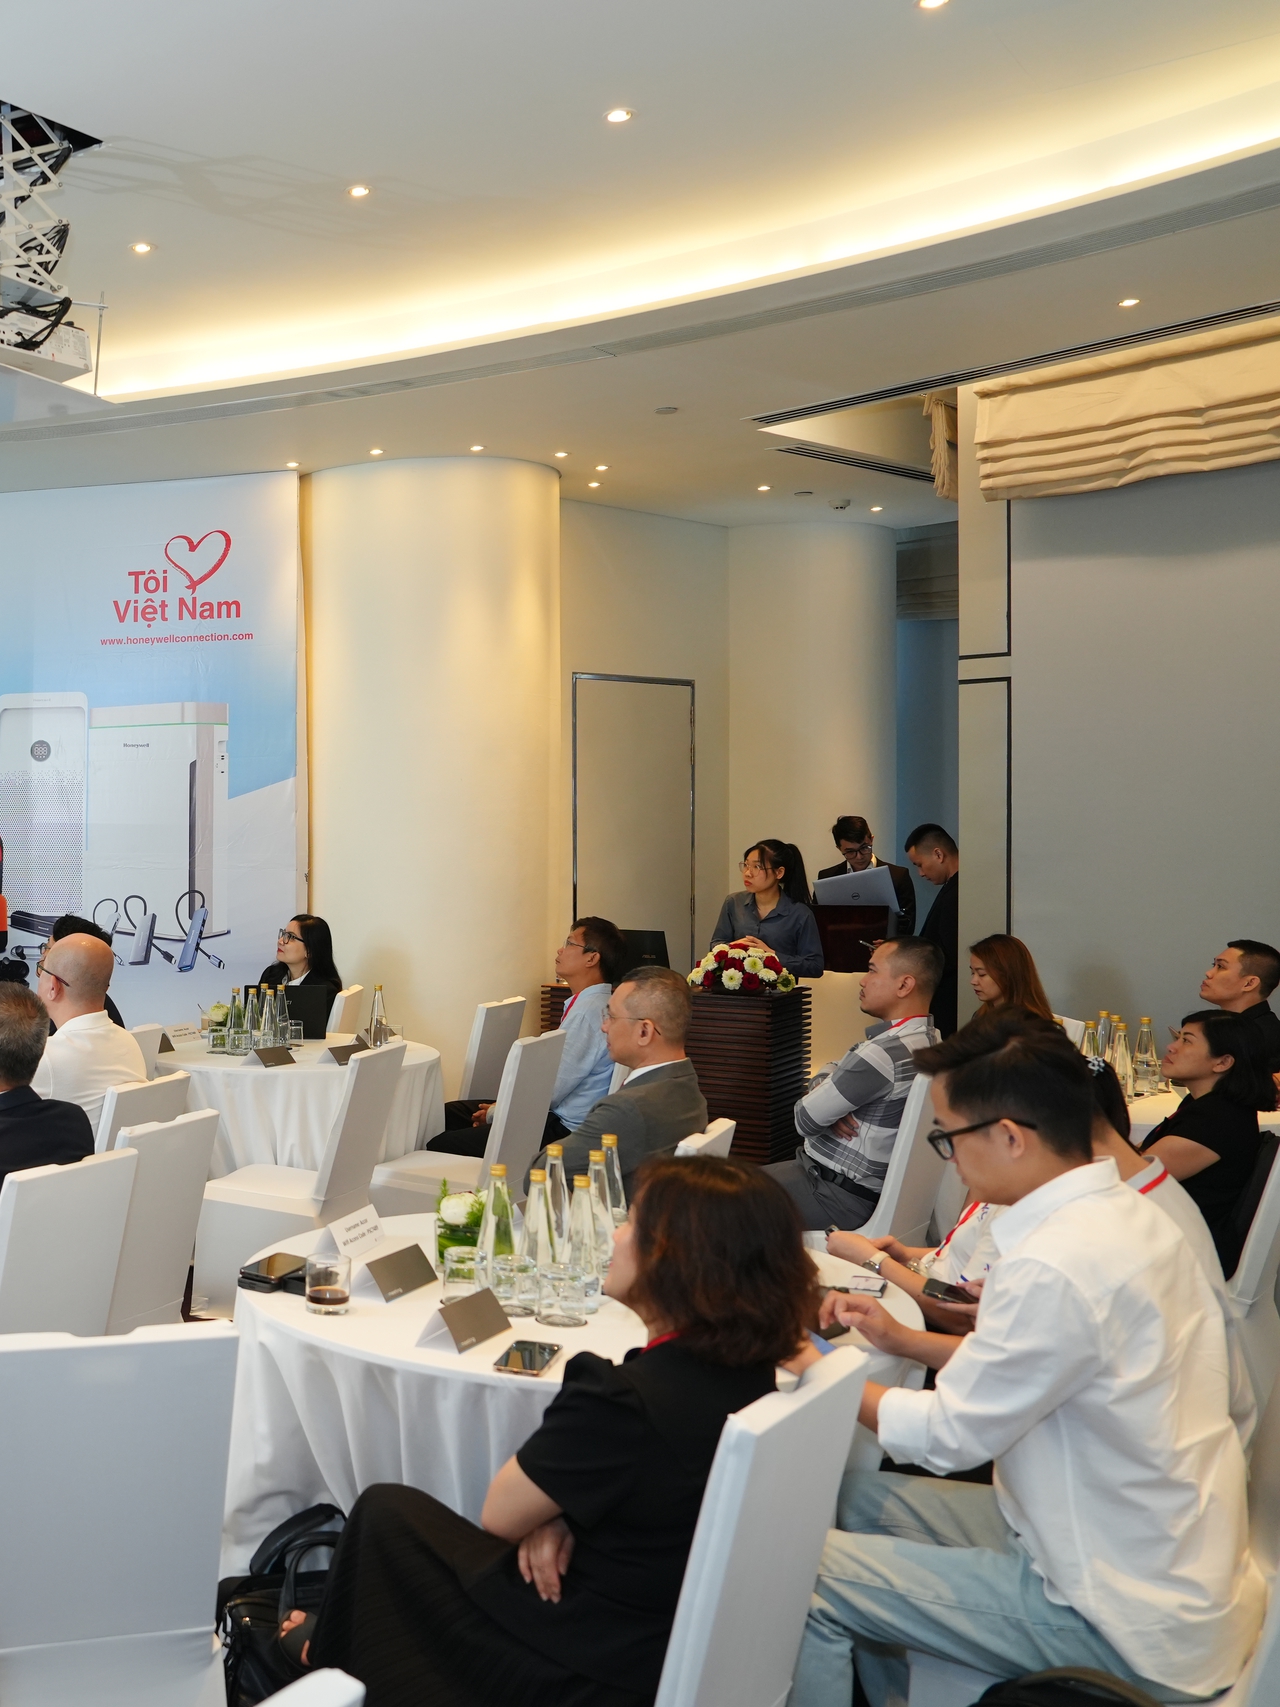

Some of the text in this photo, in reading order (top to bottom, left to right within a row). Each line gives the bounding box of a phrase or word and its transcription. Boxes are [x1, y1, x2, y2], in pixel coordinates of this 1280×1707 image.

[127, 569, 168, 595] Tôi
[112, 596, 241, 629] Việt Nam
[100, 631, 254, 647] www.honeywellconnection.com
